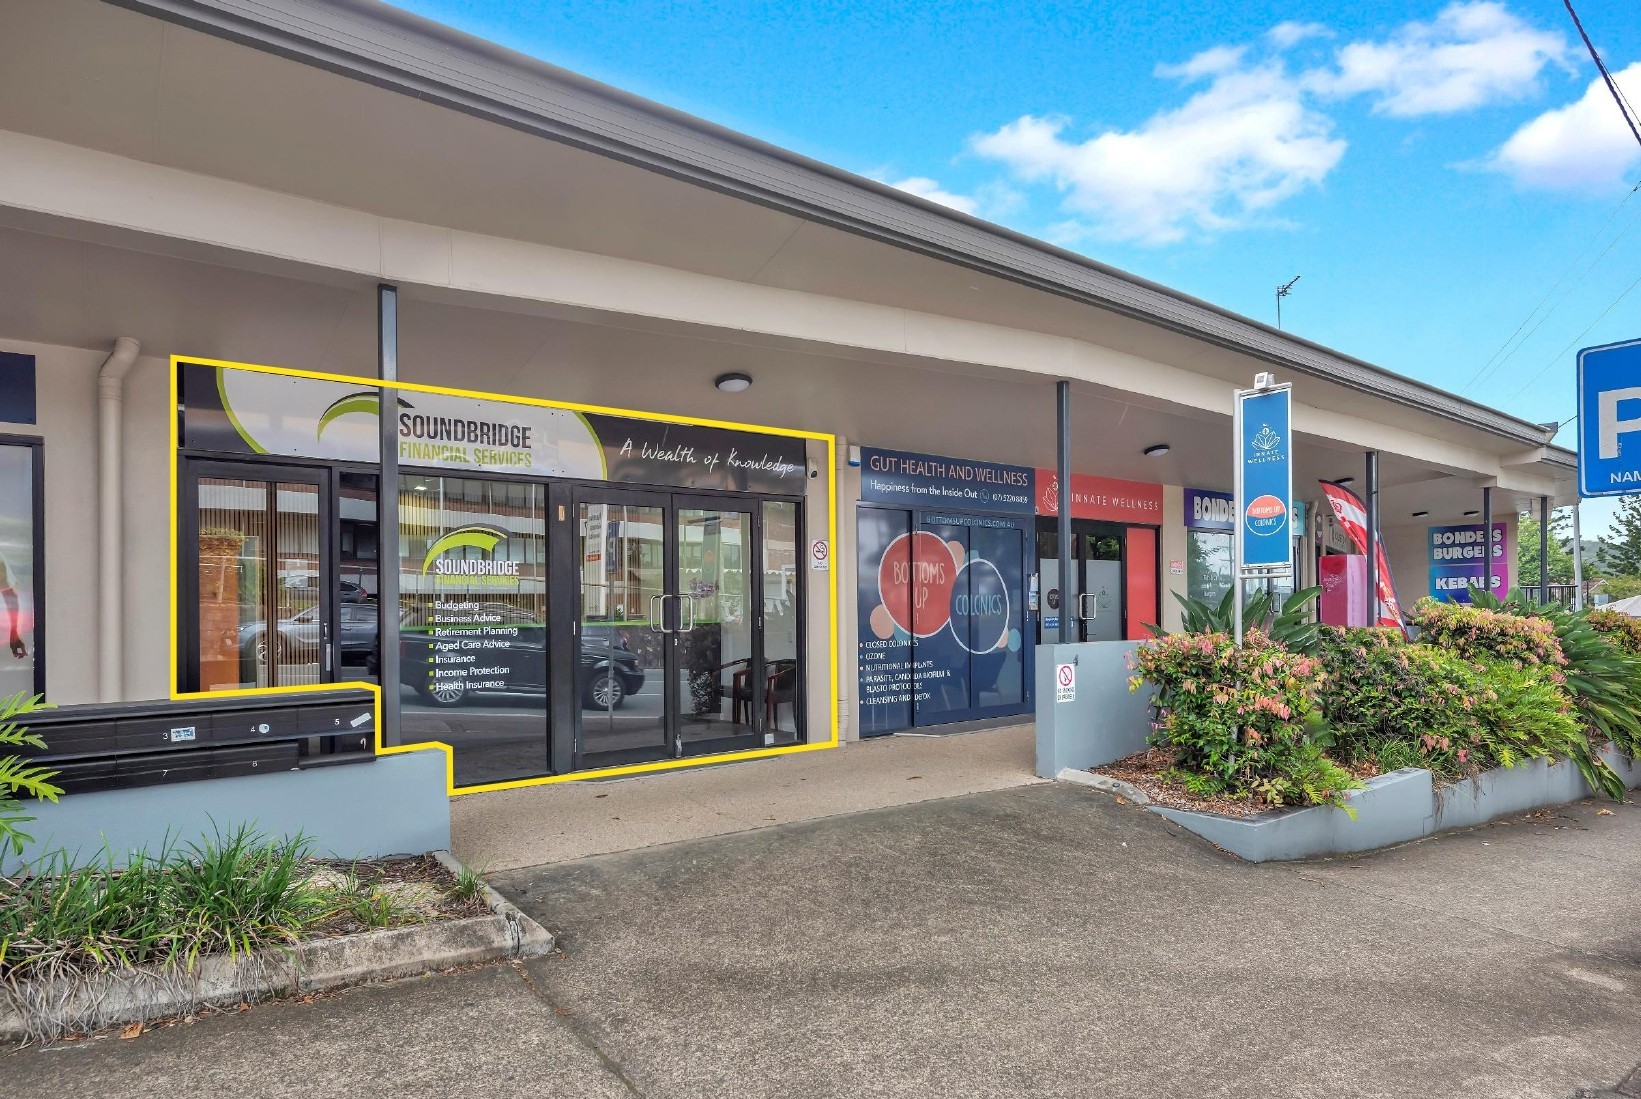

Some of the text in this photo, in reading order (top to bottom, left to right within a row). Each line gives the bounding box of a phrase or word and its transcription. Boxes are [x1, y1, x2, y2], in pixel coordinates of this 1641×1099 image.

[399, 412, 532, 449] SOUNDBRIDGE
[400, 441, 532, 468] FINANCIAL SERVICES
[619, 437, 795, 478] A Wealth of Knowledge
[1247, 455, 1285, 464] WELLNESS
[870, 455, 1028, 487] GUT HEALTH AND WELLNESS
[870, 479, 978, 500] Happiness from the Inside Out
[1071, 492, 1159, 511] INNATE WELLNESS
[1433, 529, 1502, 545] BONDES
[436, 559, 520, 575] SOUNDBRIDGE
[893, 561, 945, 585] BOTTOMS
[915, 587, 928, 609] UP
[435, 601, 480, 611] Budgeting
[956, 594, 1001, 615] COLONICS
[435, 613, 501, 623] Business Advice
[435, 626, 518, 636] Retirement Planning
[435, 641, 460, 652] Aged
[483, 640, 510, 648] Advice
[866, 640, 888, 648] CLOSED
[435, 655, 476, 664] Insurance
[435, 666, 510, 678] Income Protection
[866, 662, 904, 671] NUTRITIONAL
[436, 680, 505, 691] Health Insurance
[866, 684, 888, 692] BLASTO
[866, 692, 931, 704] CLEANSING AND DETOX
